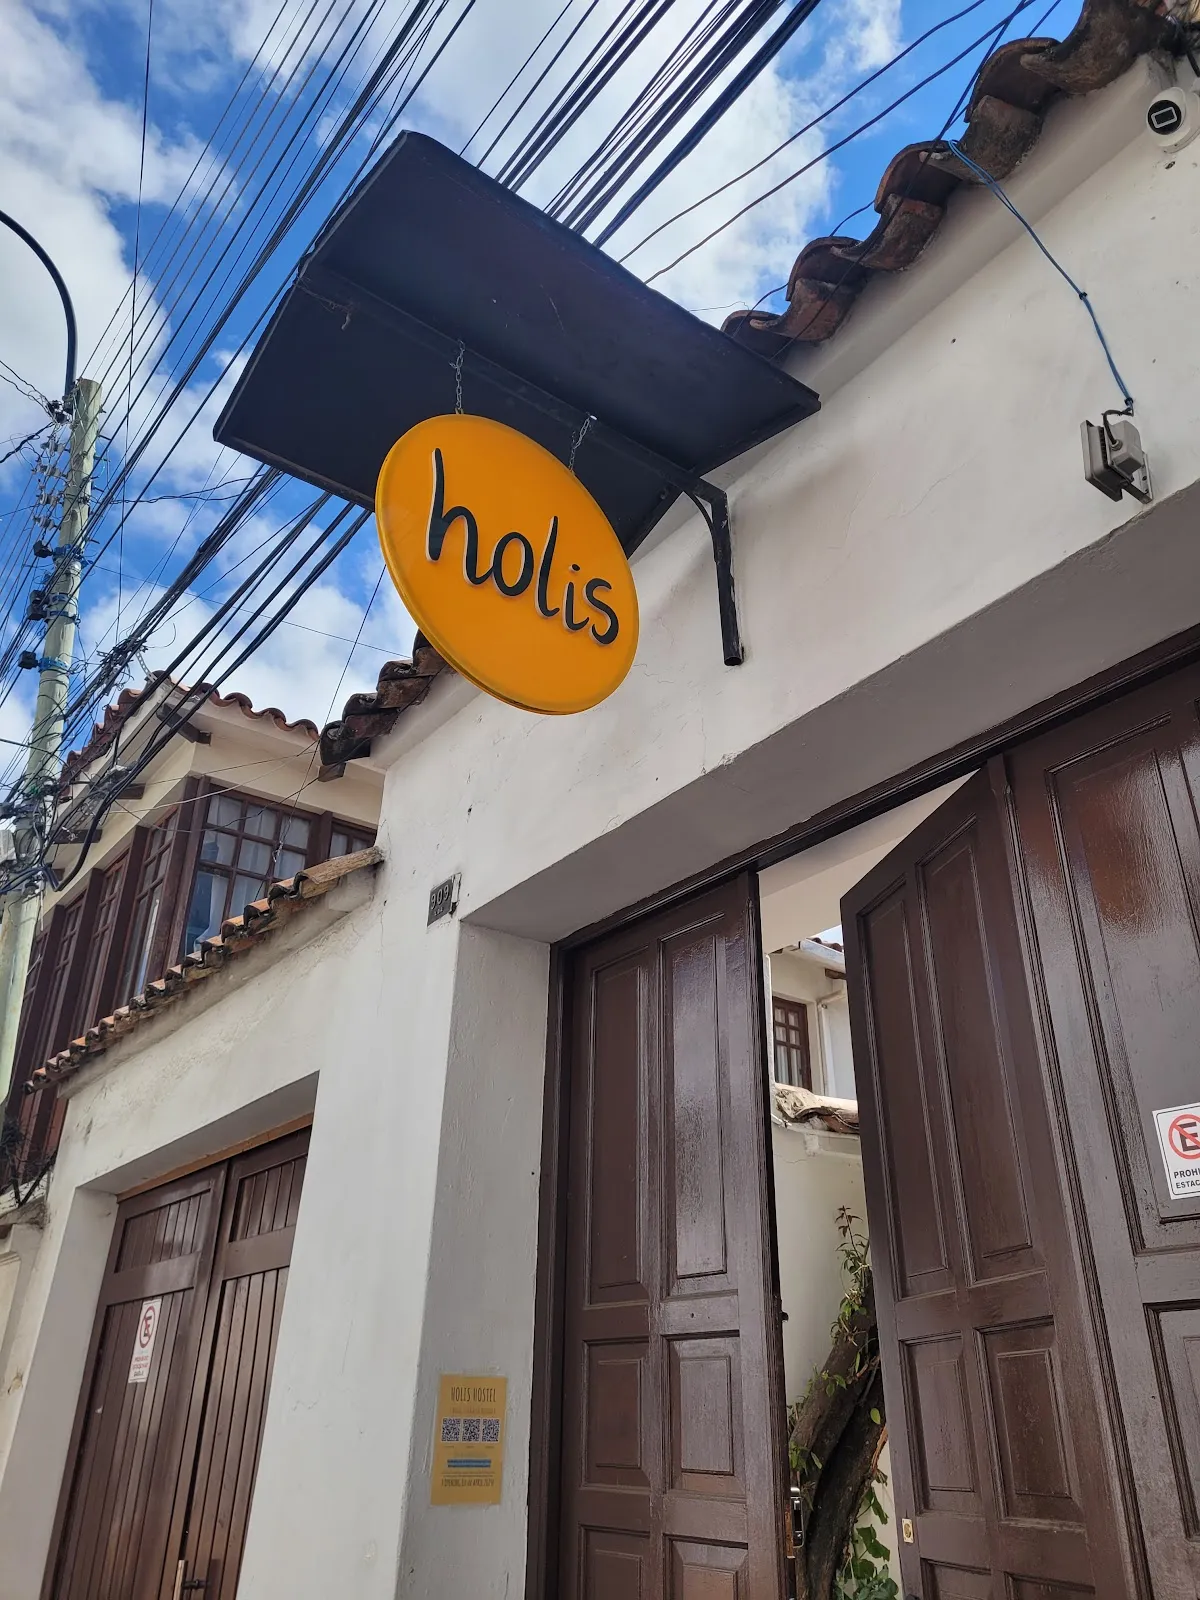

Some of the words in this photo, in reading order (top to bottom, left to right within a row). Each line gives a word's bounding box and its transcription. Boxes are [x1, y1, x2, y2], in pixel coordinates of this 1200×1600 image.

[426, 447, 619, 646] holis
[431, 884, 450, 910] 909
[473, 1387, 497, 1403] HOSTEL
